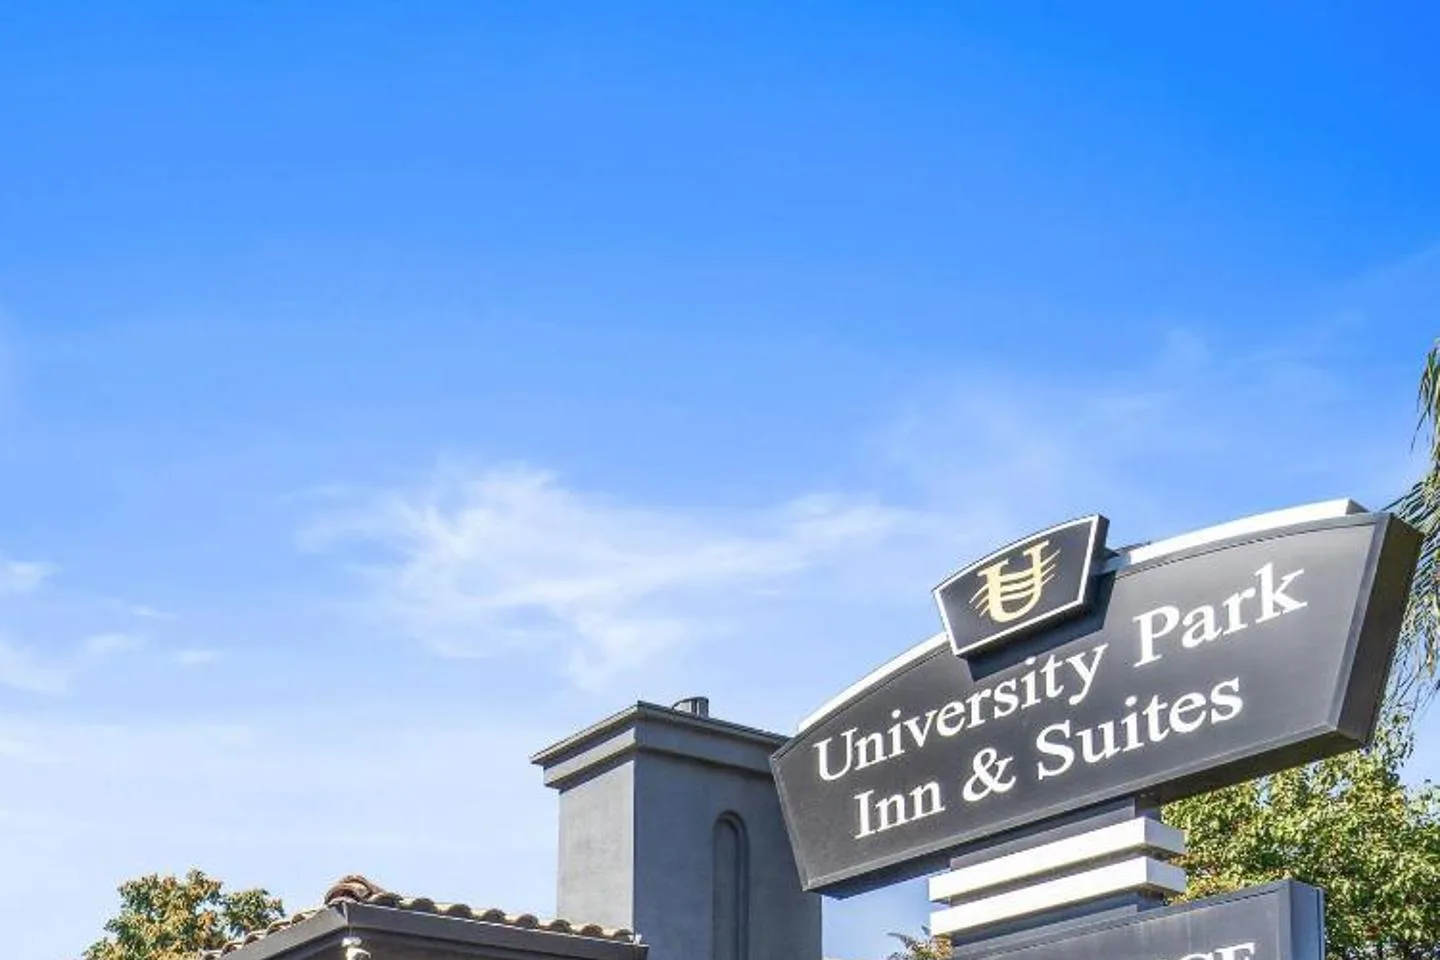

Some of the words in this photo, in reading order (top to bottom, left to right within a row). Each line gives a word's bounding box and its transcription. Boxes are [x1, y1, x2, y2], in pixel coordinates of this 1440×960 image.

[813, 646, 1109, 782] University
[1132, 561, 1308, 668] Park
[854, 781, 945, 840] Inn
[962, 746, 1017, 803] &
[1036, 677, 1244, 781] Suites
